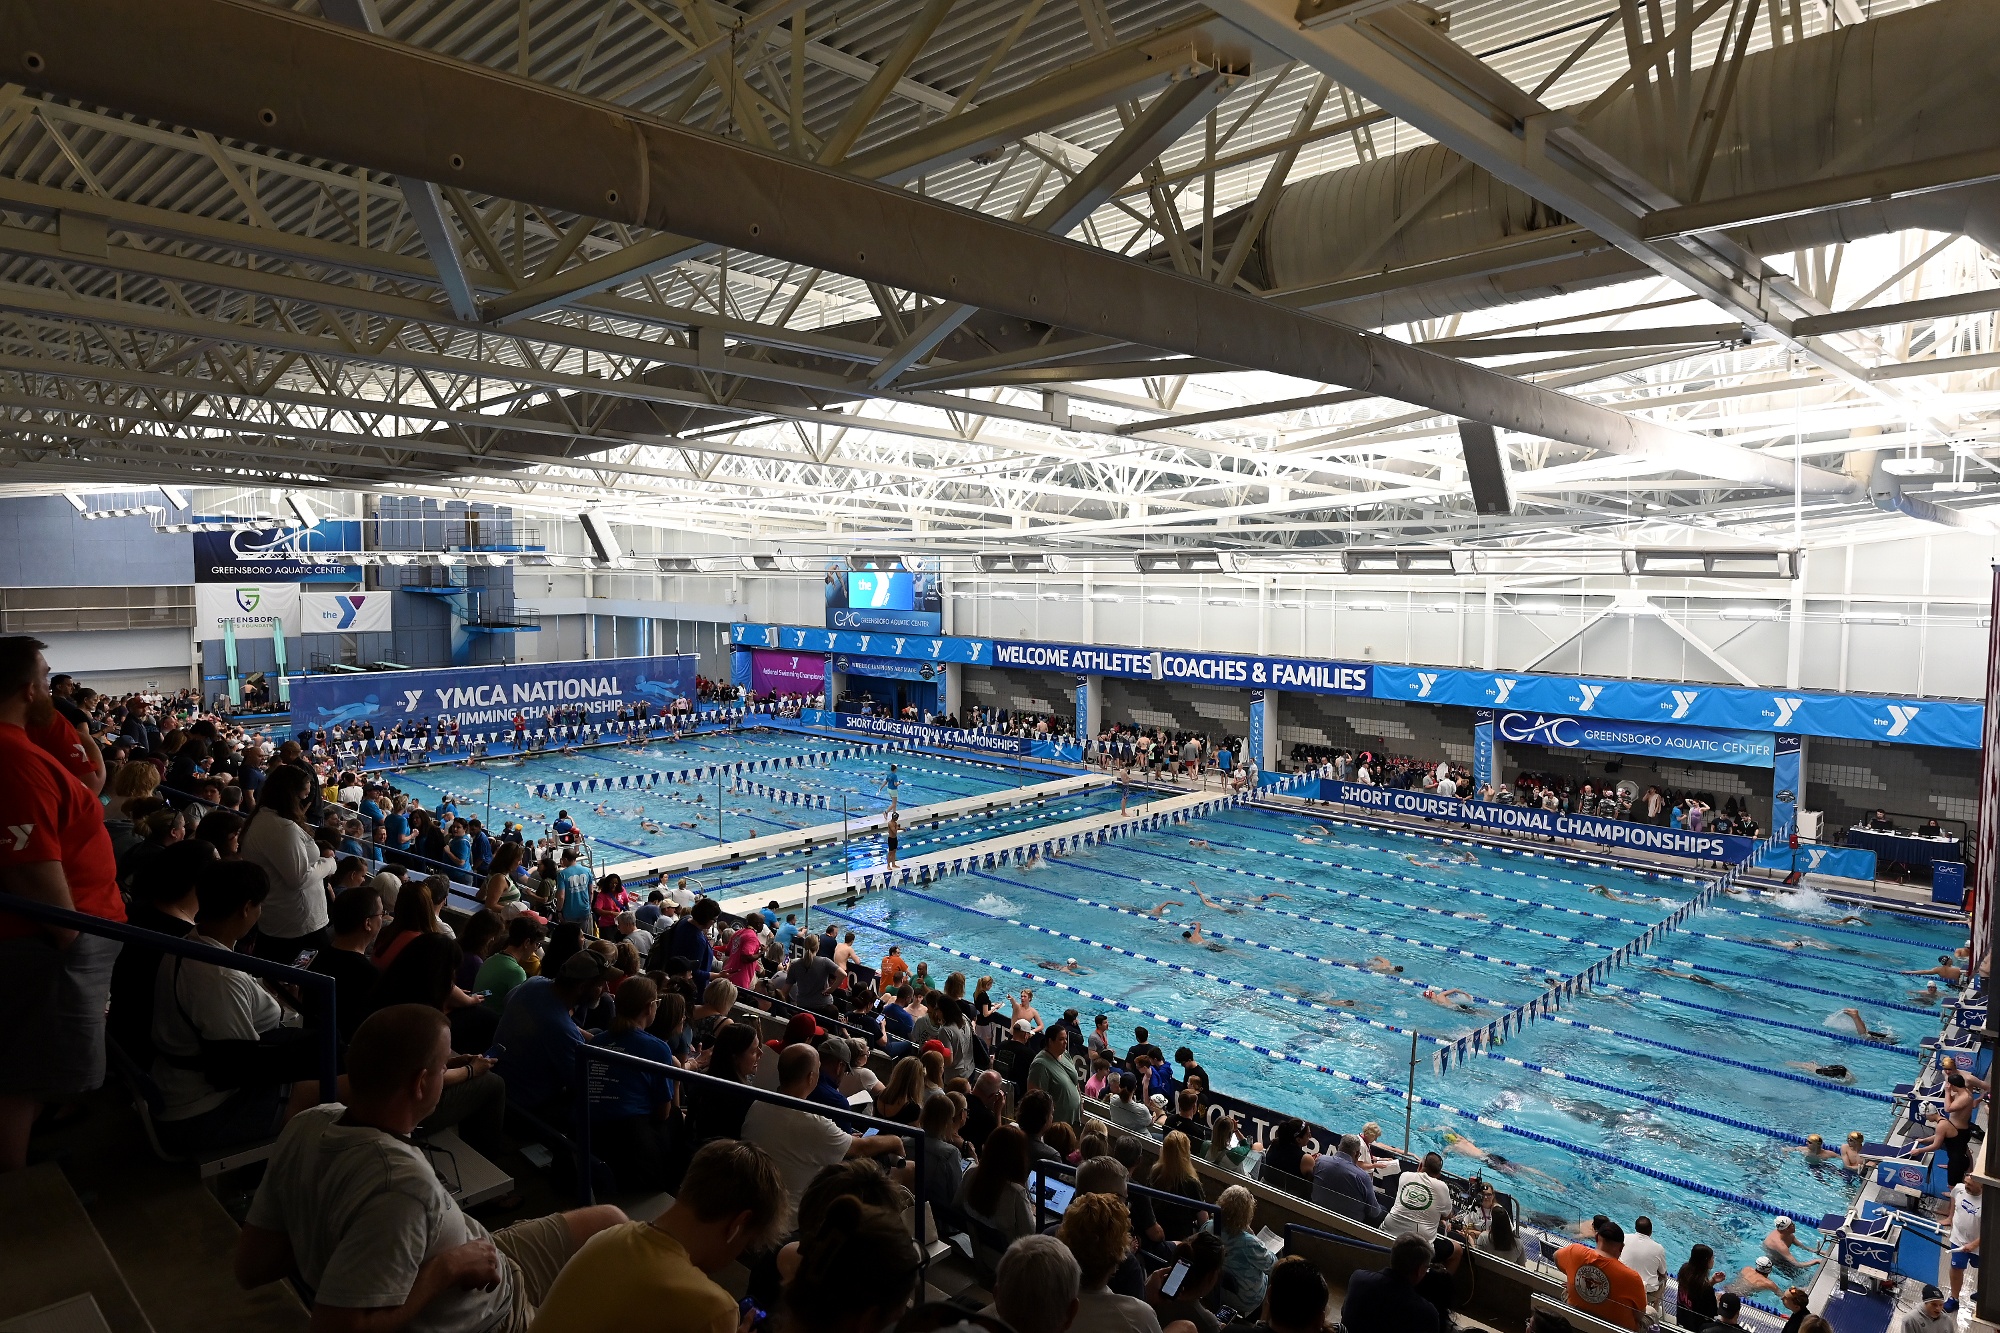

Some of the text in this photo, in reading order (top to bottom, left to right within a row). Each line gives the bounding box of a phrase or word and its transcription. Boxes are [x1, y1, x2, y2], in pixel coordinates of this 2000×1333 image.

[211, 566, 346, 575] GREENSBORO AQUATIC CENTER
[858, 579, 872, 591] the
[322, 610, 337, 619] the
[335, 595, 366, 630] Y
[910, 619, 930, 628] CENTER
[997, 644, 1366, 691] WELCOME ATHLETES COACHES & FAMILIES
[436, 676, 623, 710] YMCA NATIONAL
[1568, 695, 1580, 703] the
[1660, 702, 1673, 710] the
[1761, 709, 1775, 717] the
[846, 717, 871, 730] SHORT
[871, 717, 901, 734] COURSE
[1873, 718, 1889, 726] the
[1584, 729, 1662, 746] GREENSBORO
[1665, 737, 1719, 752] AQUATIC
[1722, 742, 1770, 756] CENTER
[1341, 785, 1724, 856] SHORT COURSE NATIONAL CHAMPIONSHIPS
[1960, 1019, 1967, 1027] 4
[1883, 1166, 1896, 1183] 7
[1844, 1254, 1853, 1265] 8
